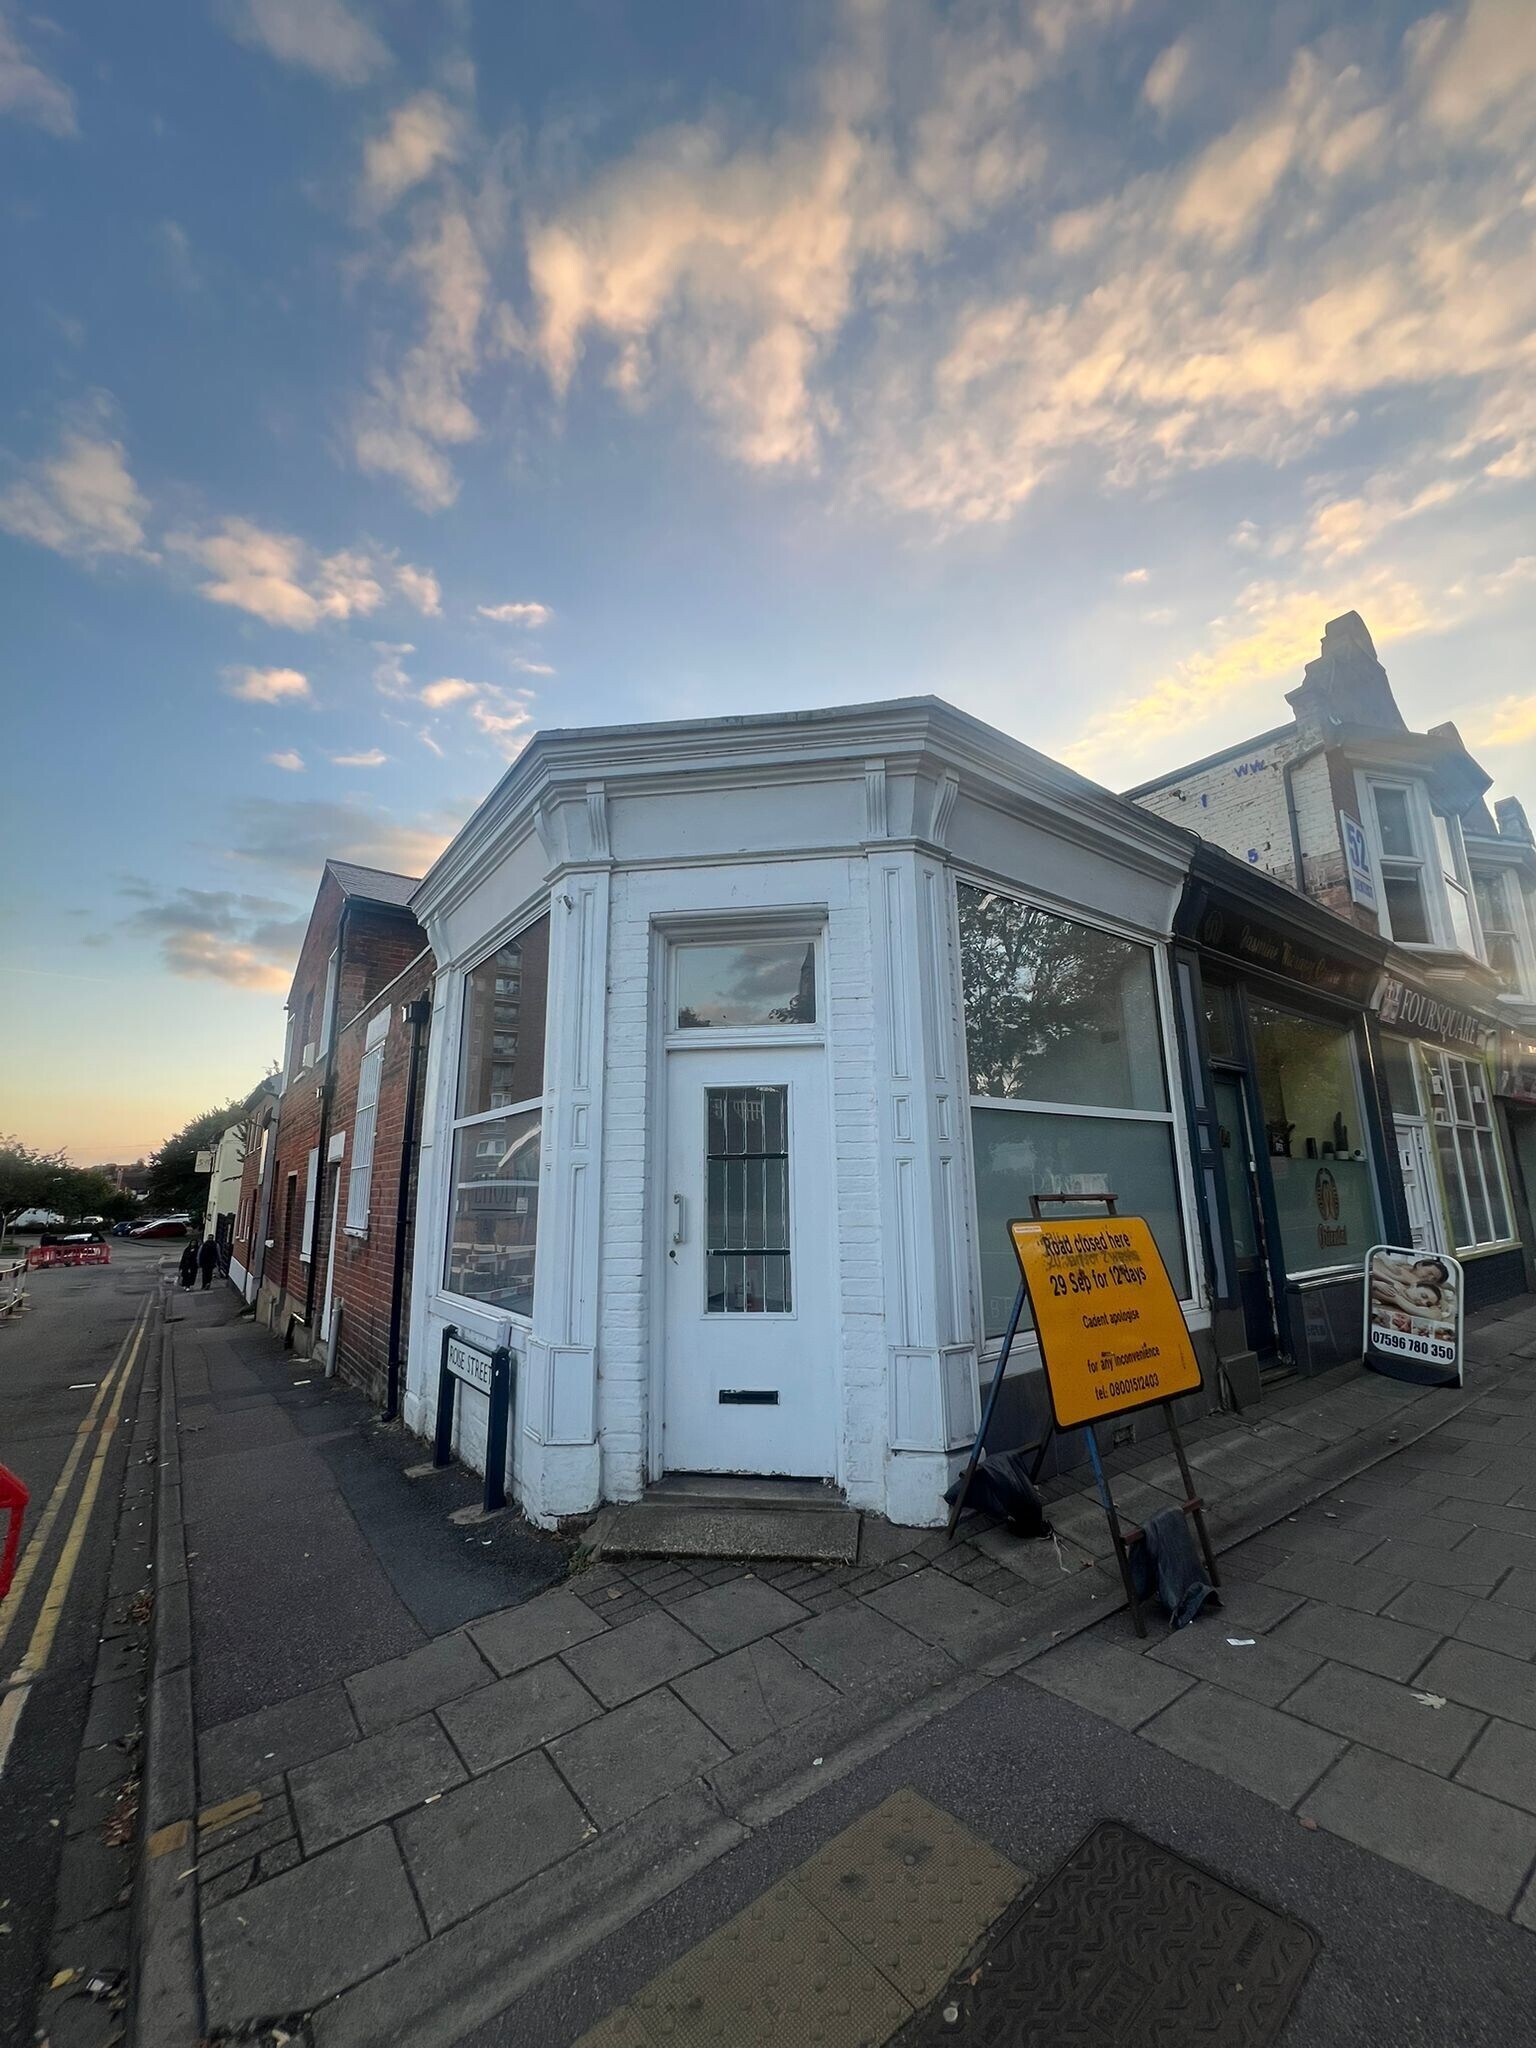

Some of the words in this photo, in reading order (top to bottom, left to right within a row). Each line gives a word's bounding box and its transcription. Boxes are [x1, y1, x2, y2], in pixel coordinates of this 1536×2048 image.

[1346, 822, 1370, 873] 52
[1400, 988, 1479, 1045] FOURSQUARE
[1042, 1234, 1073, 1256] Road
[1074, 1231, 1108, 1253] closed
[1106, 1231, 1131, 1248] here
[1050, 1274, 1067, 1296] 29
[1069, 1270, 1092, 1295] Sep
[1091, 1269, 1109, 1288] for
[1109, 1265, 1123, 1286] 12
[1122, 1264, 1147, 1286] days
[1082, 1313, 1109, 1330] Cadent
[1109, 1308, 1140, 1326] apologise
[1087, 1359, 1099, 1374] for
[1100, 1356, 1115, 1374] any
[1114, 1345, 1160, 1367] inconvenience
[1372, 1331, 1406, 1350] 07596
[1408, 1338, 1429, 1355] 780
[1430, 1344, 1454, 1360] 350
[449, 1345, 465, 1370] ROSE
[467, 1355, 493, 1385] STREET
[1095, 1385, 1109, 1401] tel:
[1109, 1373, 1160, 1398] 08001512403
